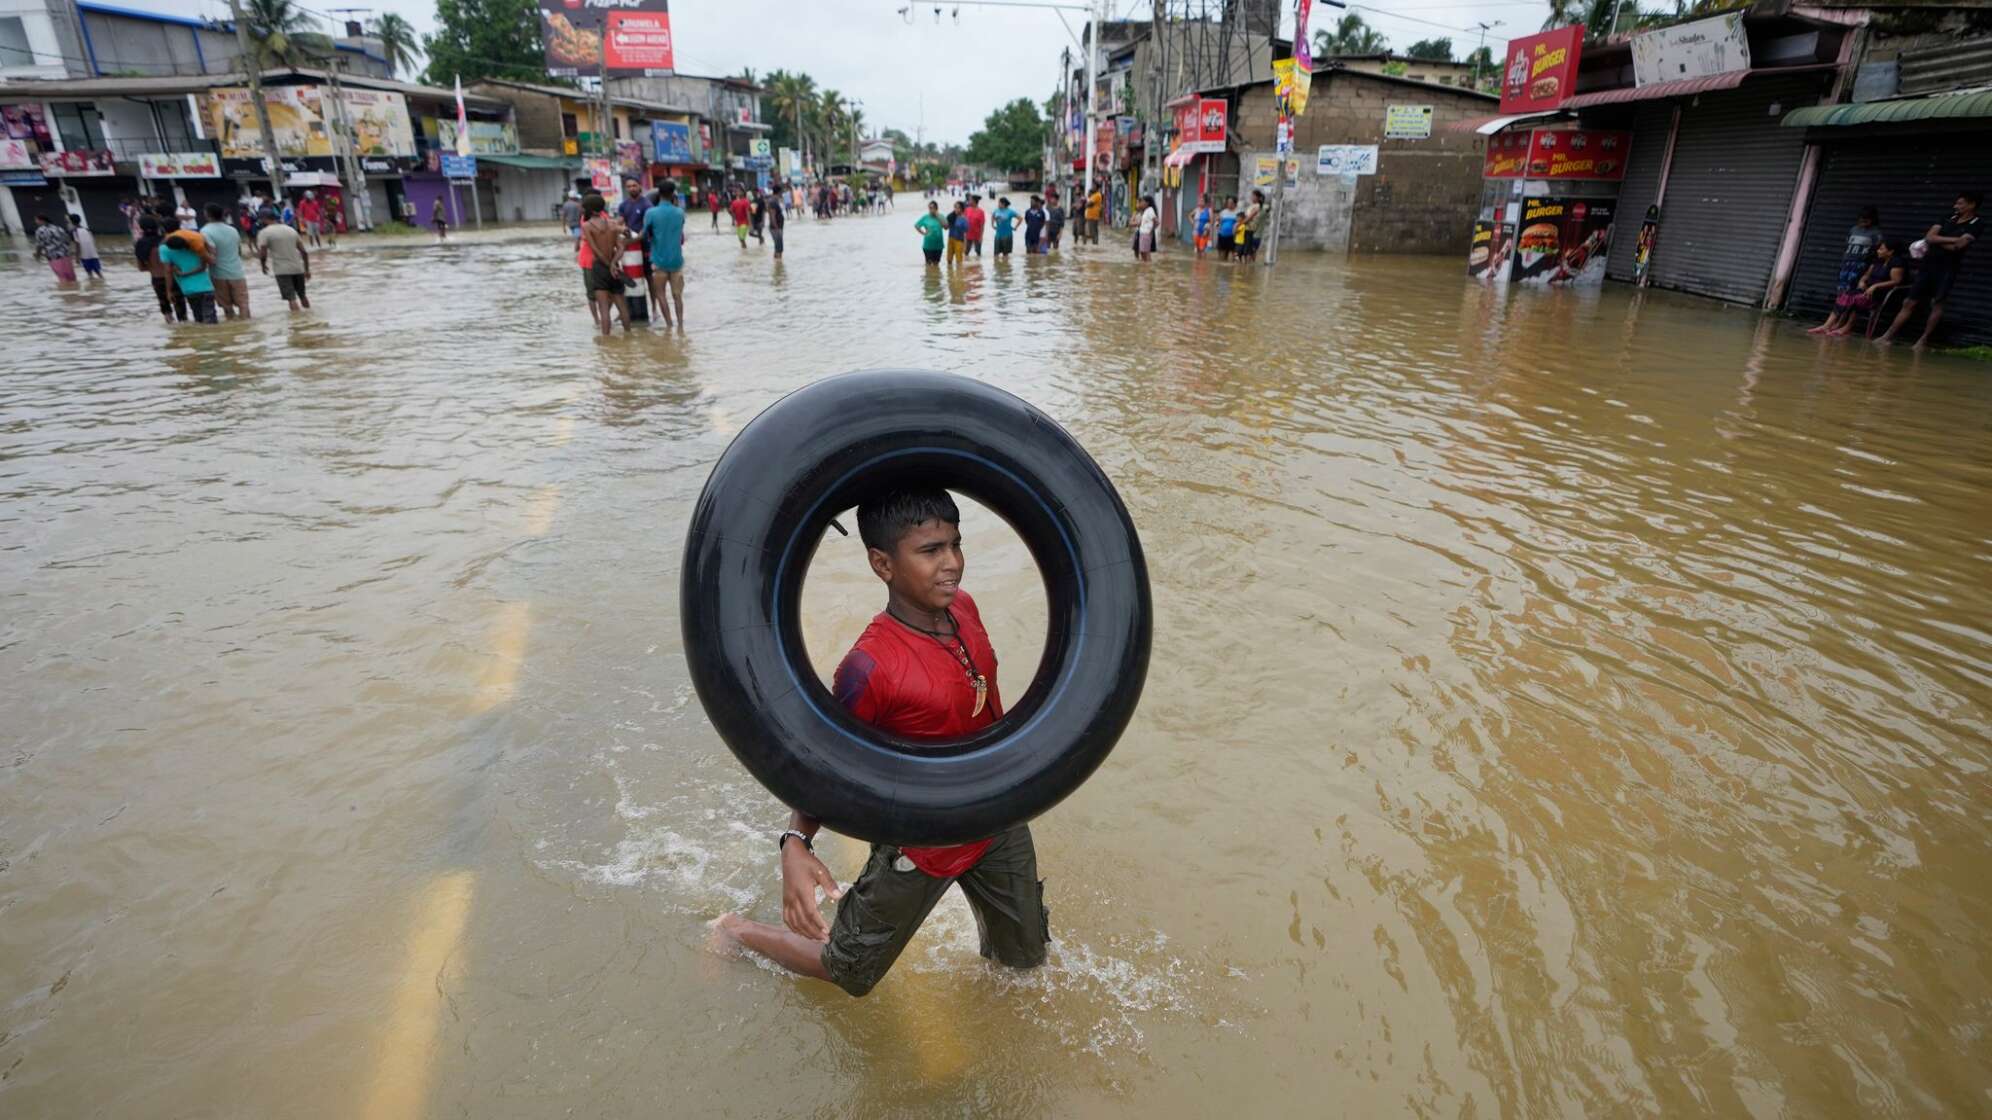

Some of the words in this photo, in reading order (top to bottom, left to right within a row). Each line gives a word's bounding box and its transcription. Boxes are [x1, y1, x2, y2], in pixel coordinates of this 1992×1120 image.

[1532, 48, 1566, 78] BURGER
[1550, 160, 1593, 176] BURGER
[1525, 205, 1563, 220] BURGER
